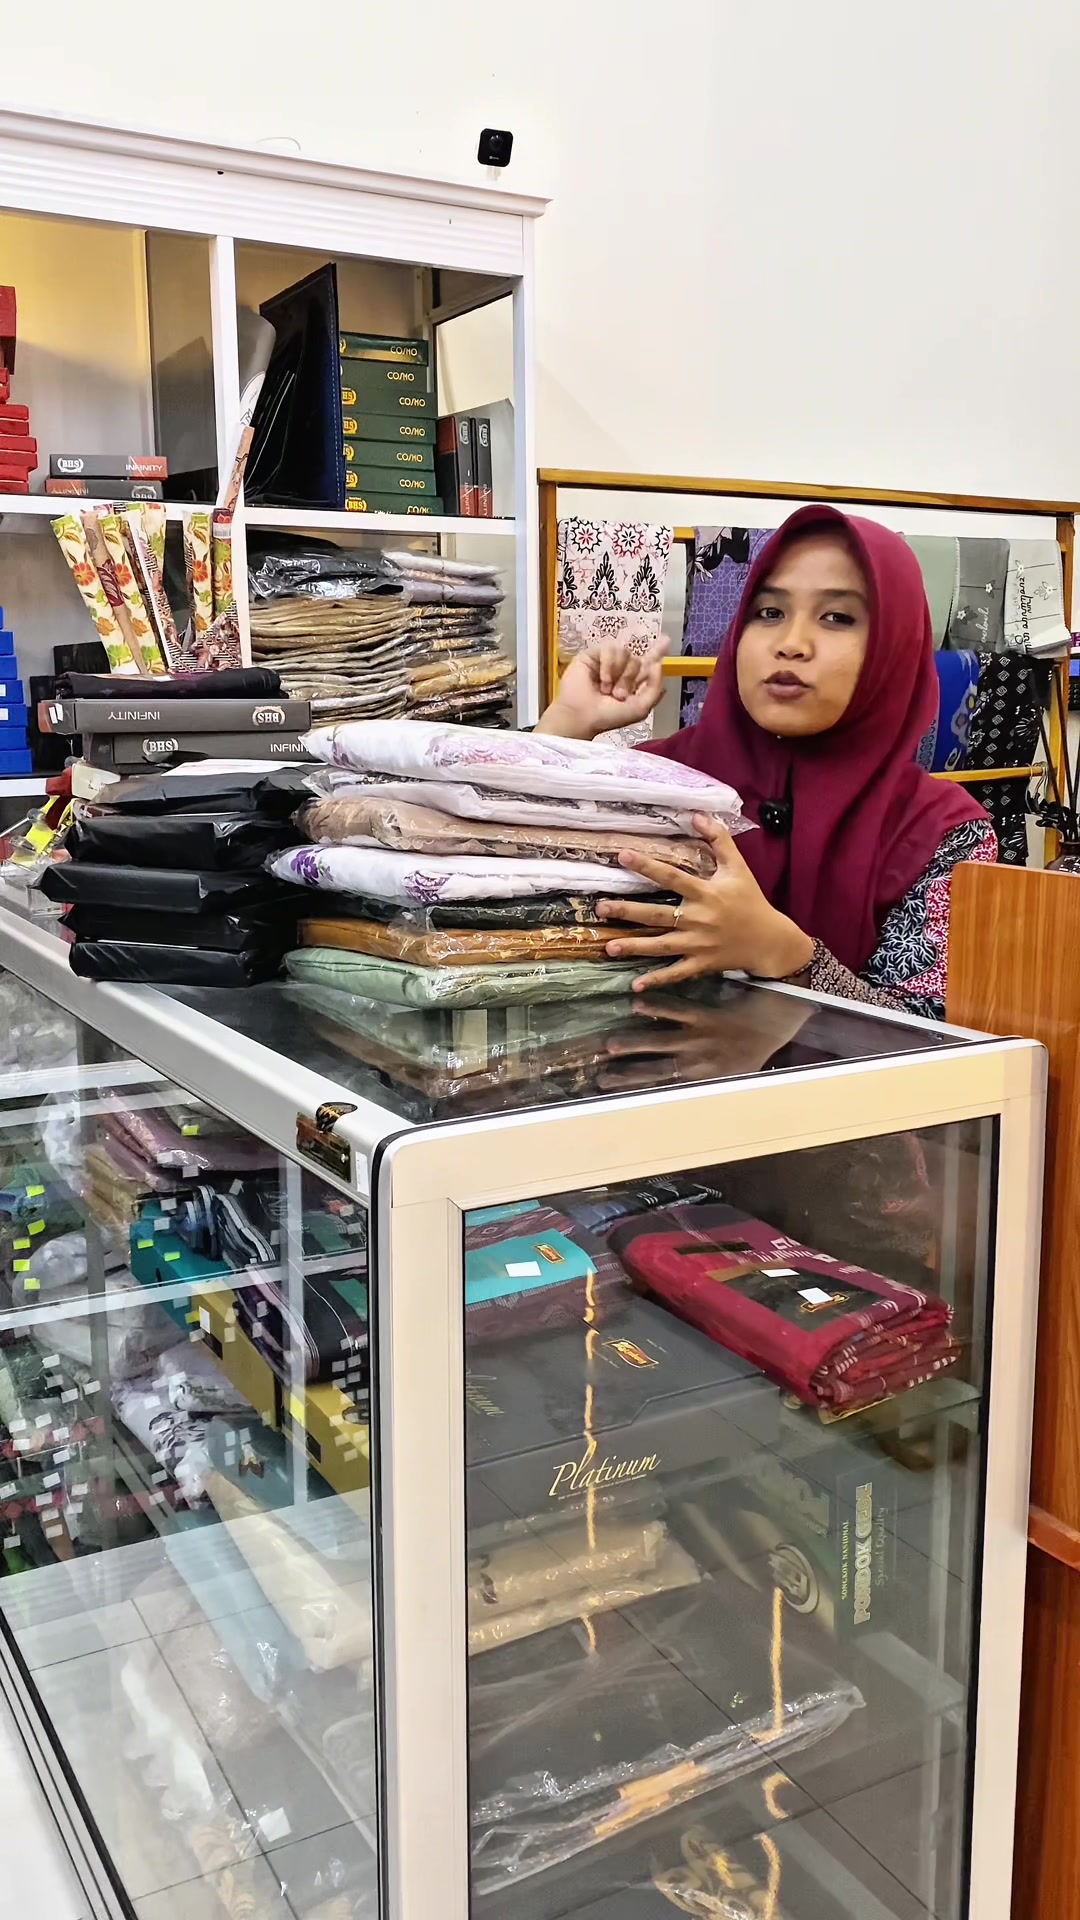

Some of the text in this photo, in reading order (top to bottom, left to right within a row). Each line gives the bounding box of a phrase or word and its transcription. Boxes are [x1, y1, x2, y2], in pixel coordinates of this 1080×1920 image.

[387, 371, 415, 382] COSMO
[399, 397, 426, 407] COSMO
[399, 426, 425, 437] COSMO
[396, 452, 423, 462] COSMO
[62, 459, 163, 472] BHS INFINITY
[399, 479, 425, 489] COSMO
[107, 711, 161, 721] INFINITY
[256, 712, 280, 723] BHS
[149, 740, 305, 753] BHS INFINI
[548, 1440, 661, 1497] Platinum
[854, 1481, 873, 1625] PONDOK GEDE
